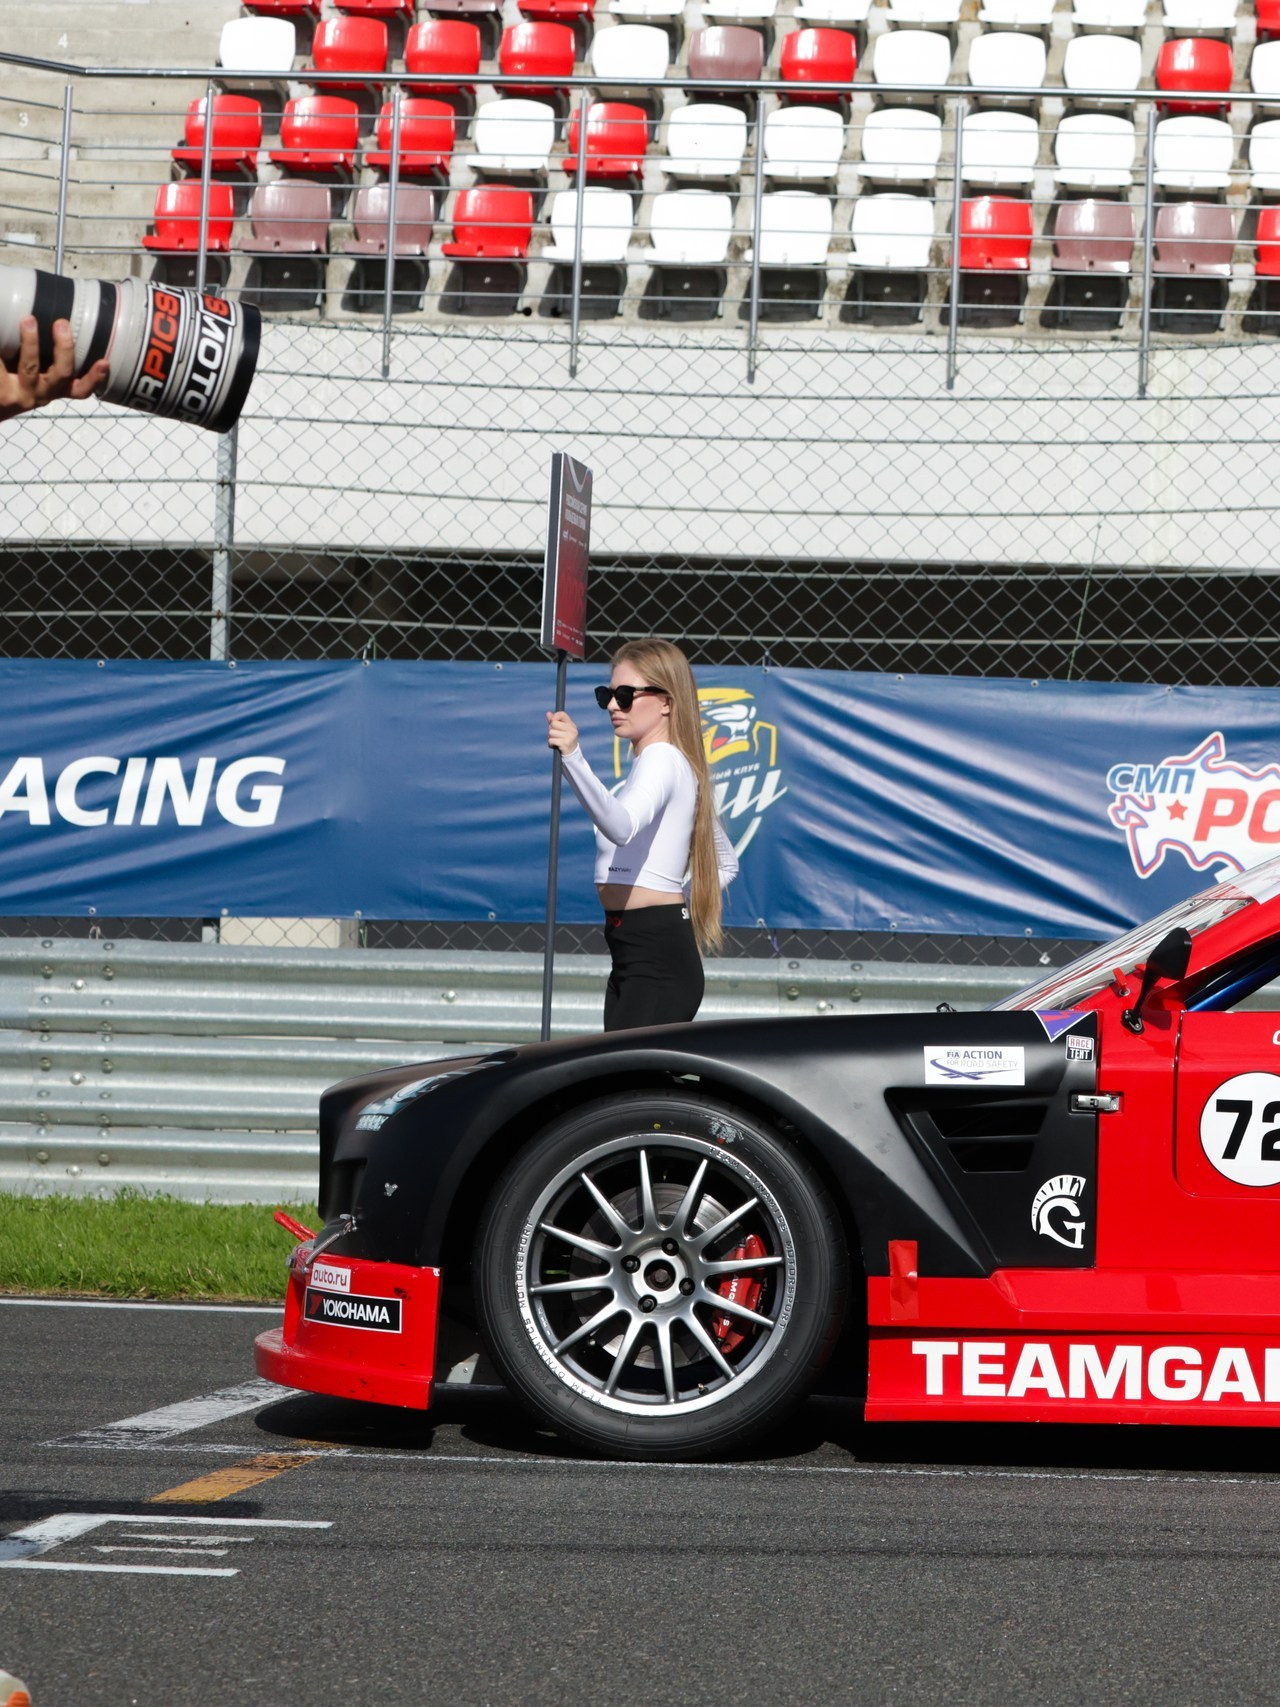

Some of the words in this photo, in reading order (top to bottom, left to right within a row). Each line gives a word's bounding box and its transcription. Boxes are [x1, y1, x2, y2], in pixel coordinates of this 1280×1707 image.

[734, 763, 760, 776] КЛУБ
[1109, 767, 1196, 795] СМП
[1070, 1037, 1090, 1048] RACE
[963, 1050, 1003, 1059] ACTION
[1069, 1048, 1090, 1060] TENT
[960, 1060, 984, 1068] ROAD
[985, 1060, 1019, 1068] SAFETY
[313, 1267, 348, 1287] auto.ru
[323, 1298, 390, 1324] YOKOHAMA
